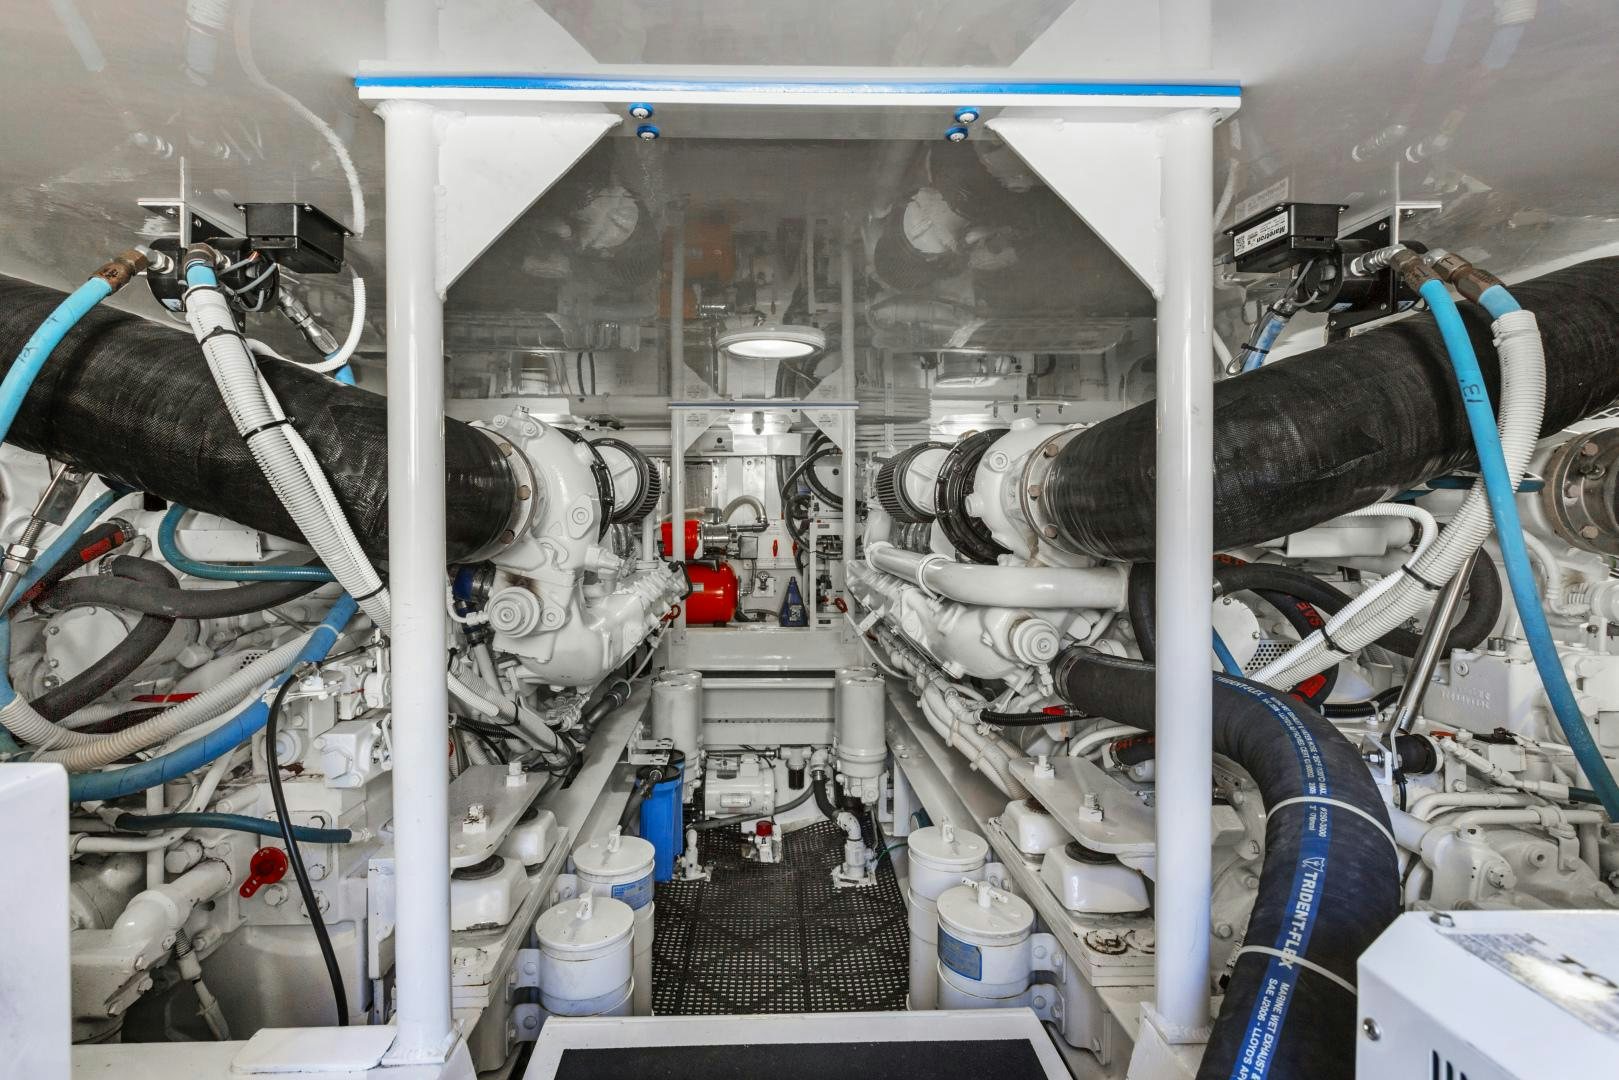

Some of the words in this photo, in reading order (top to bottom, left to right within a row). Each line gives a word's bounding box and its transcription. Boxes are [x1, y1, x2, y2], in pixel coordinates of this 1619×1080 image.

[1256, 225, 1286, 243] Maretron
[1265, 978, 1279, 997] SAE
[1272, 982, 1291, 1015] MARINE
[1257, 996, 1272, 1022] J2006
[1267, 1014, 1281, 1034] WET
[1254, 1033, 1275, 1075] EXHAUST
